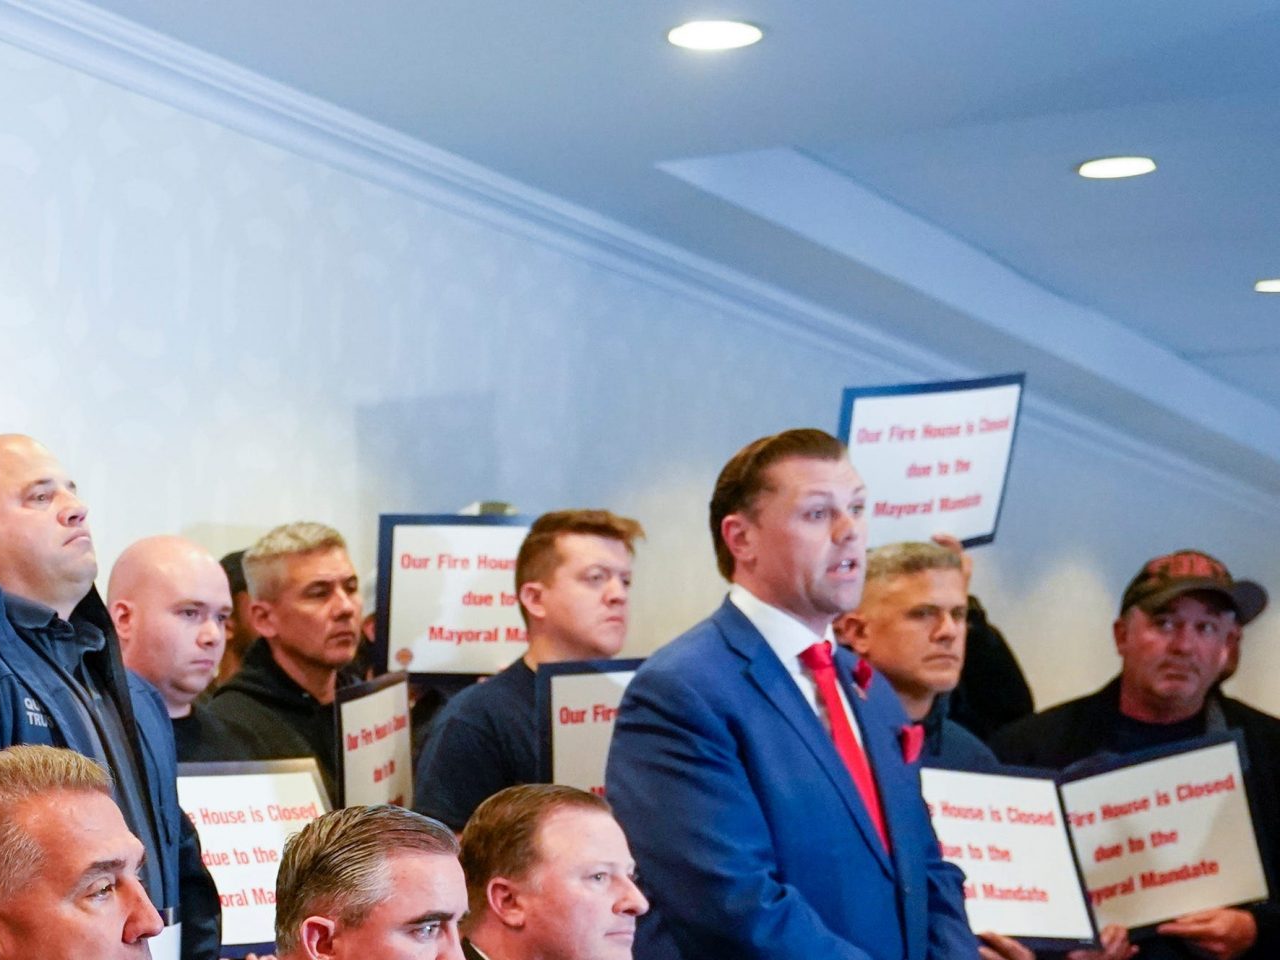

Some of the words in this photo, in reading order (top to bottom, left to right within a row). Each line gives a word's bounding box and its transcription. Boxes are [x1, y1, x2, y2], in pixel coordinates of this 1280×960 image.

[401, 553, 430, 569] Our
[438, 553, 469, 569] Fire
[462, 591, 494, 605] due
[429, 626, 498, 644] Mayoral
[559, 706, 586, 724] Our
[593, 704, 618, 722] Fir
[1100, 798, 1150, 821] House
[1156, 790, 1171, 806] is
[1176, 774, 1235, 801] Closed
[200, 807, 246, 825] House
[249, 805, 264, 822] is
[267, 802, 320, 821] Closed
[940, 801, 984, 821] House
[988, 804, 1002, 822] is
[1007, 806, 1056, 827] Closed
[233, 848, 249, 864] to
[252, 846, 279, 864] the
[967, 844, 982, 860] to
[987, 845, 1010, 862] the
[1094, 844, 1123, 863] due
[1128, 837, 1145, 854] to
[1150, 830, 1178, 848] the
[1140, 860, 1219, 889] Mandate
[982, 883, 1048, 902] Mandate
